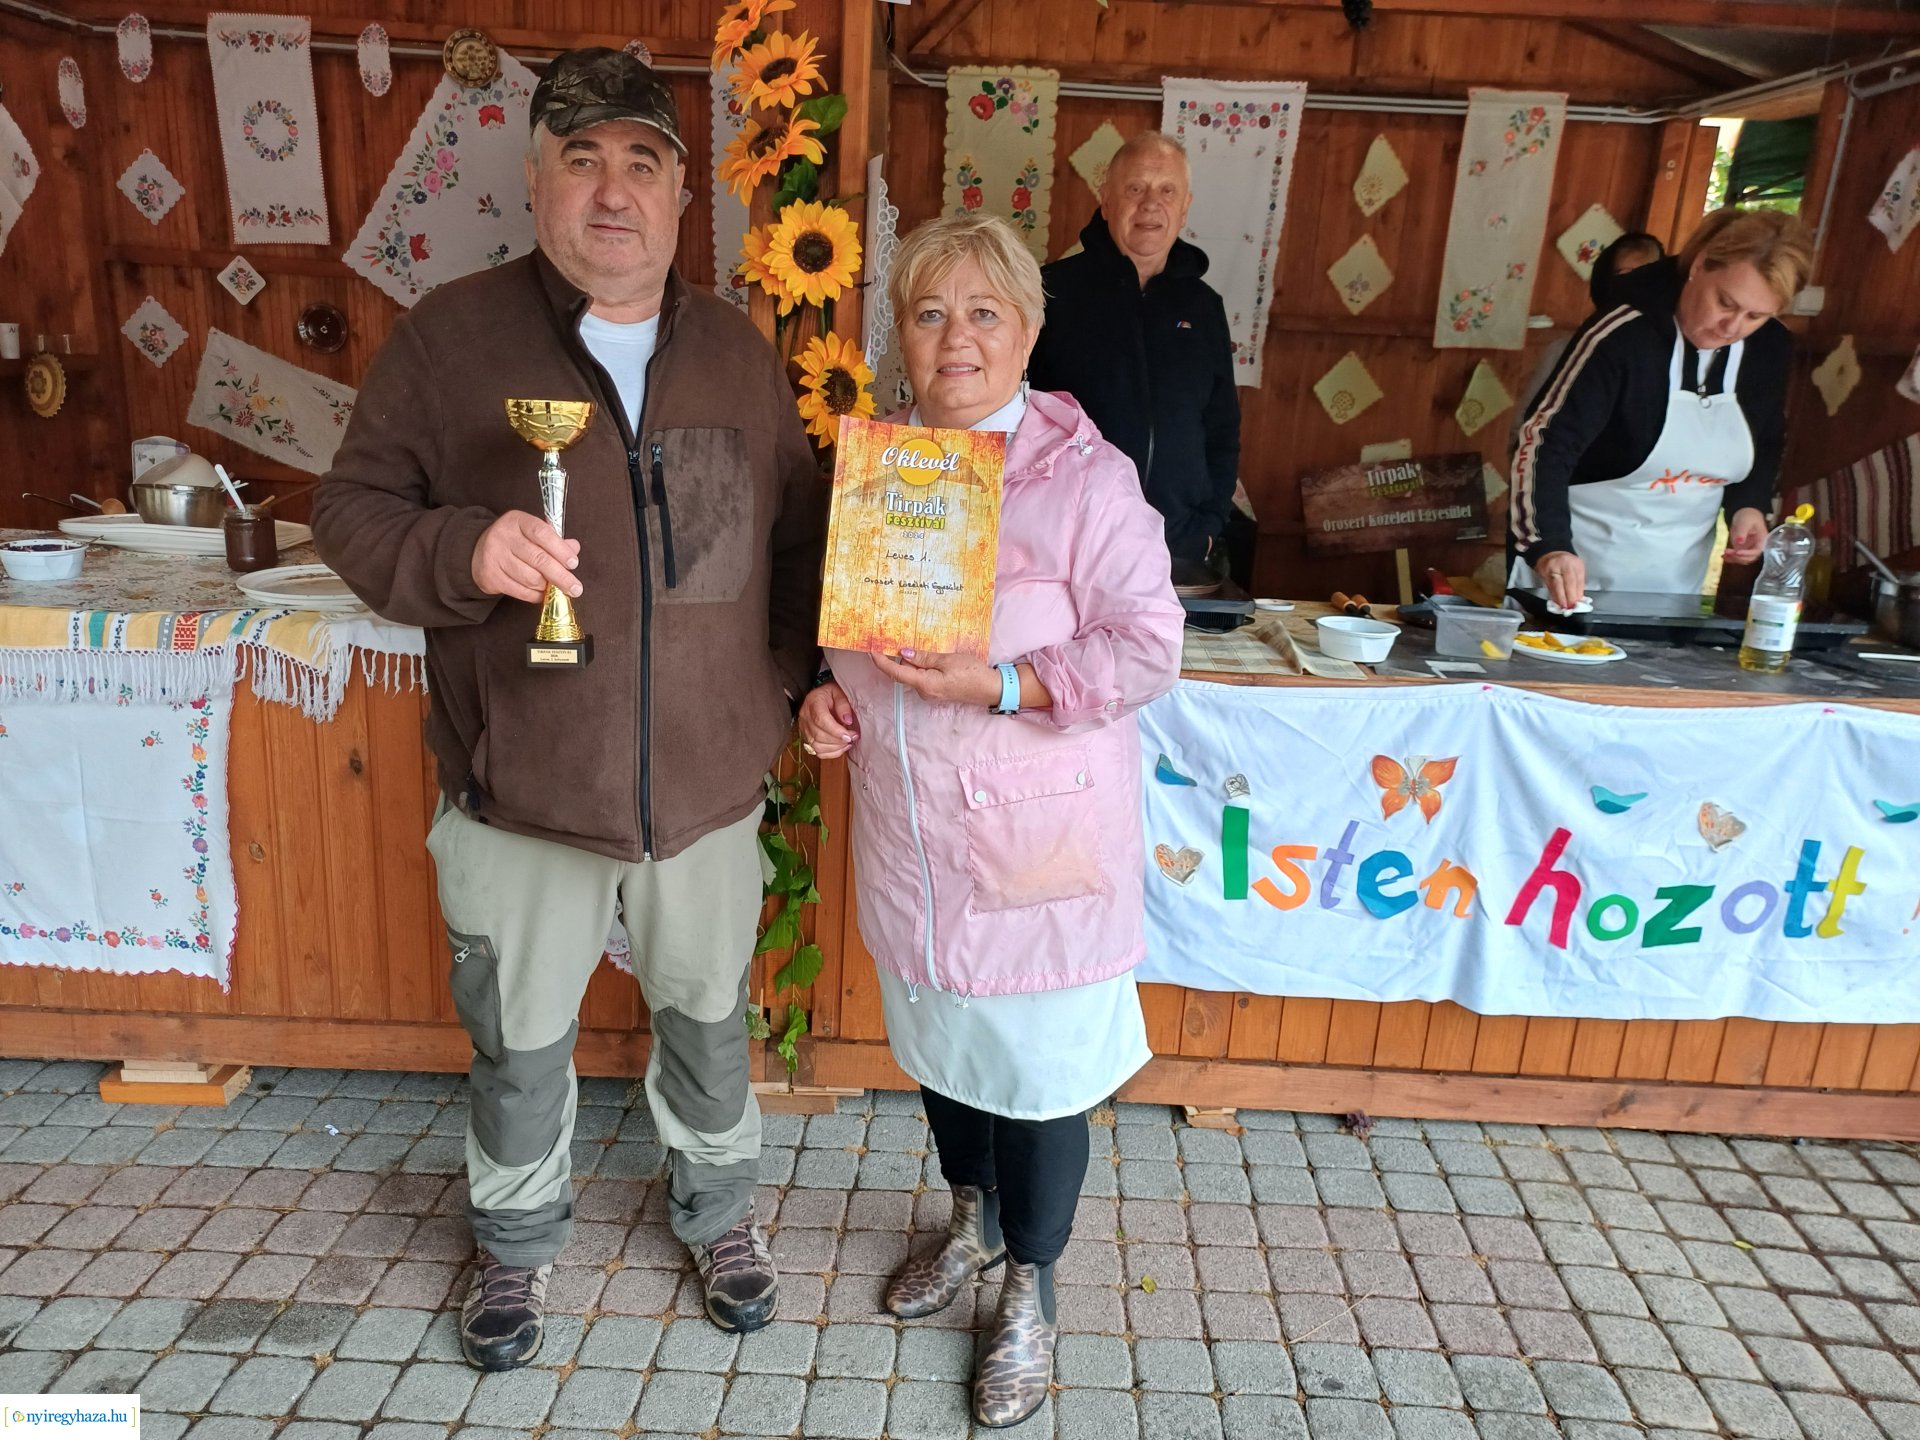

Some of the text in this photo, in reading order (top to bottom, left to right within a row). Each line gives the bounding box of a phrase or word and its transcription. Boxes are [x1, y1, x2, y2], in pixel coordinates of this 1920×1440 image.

[881, 447, 960, 471] Oklevél
[886, 491, 946, 517] Tirpák
[885, 513, 946, 530] Fesztivál
[885, 549, 915, 562] Leves
[1221, 804, 1867, 950] Isten hozott
